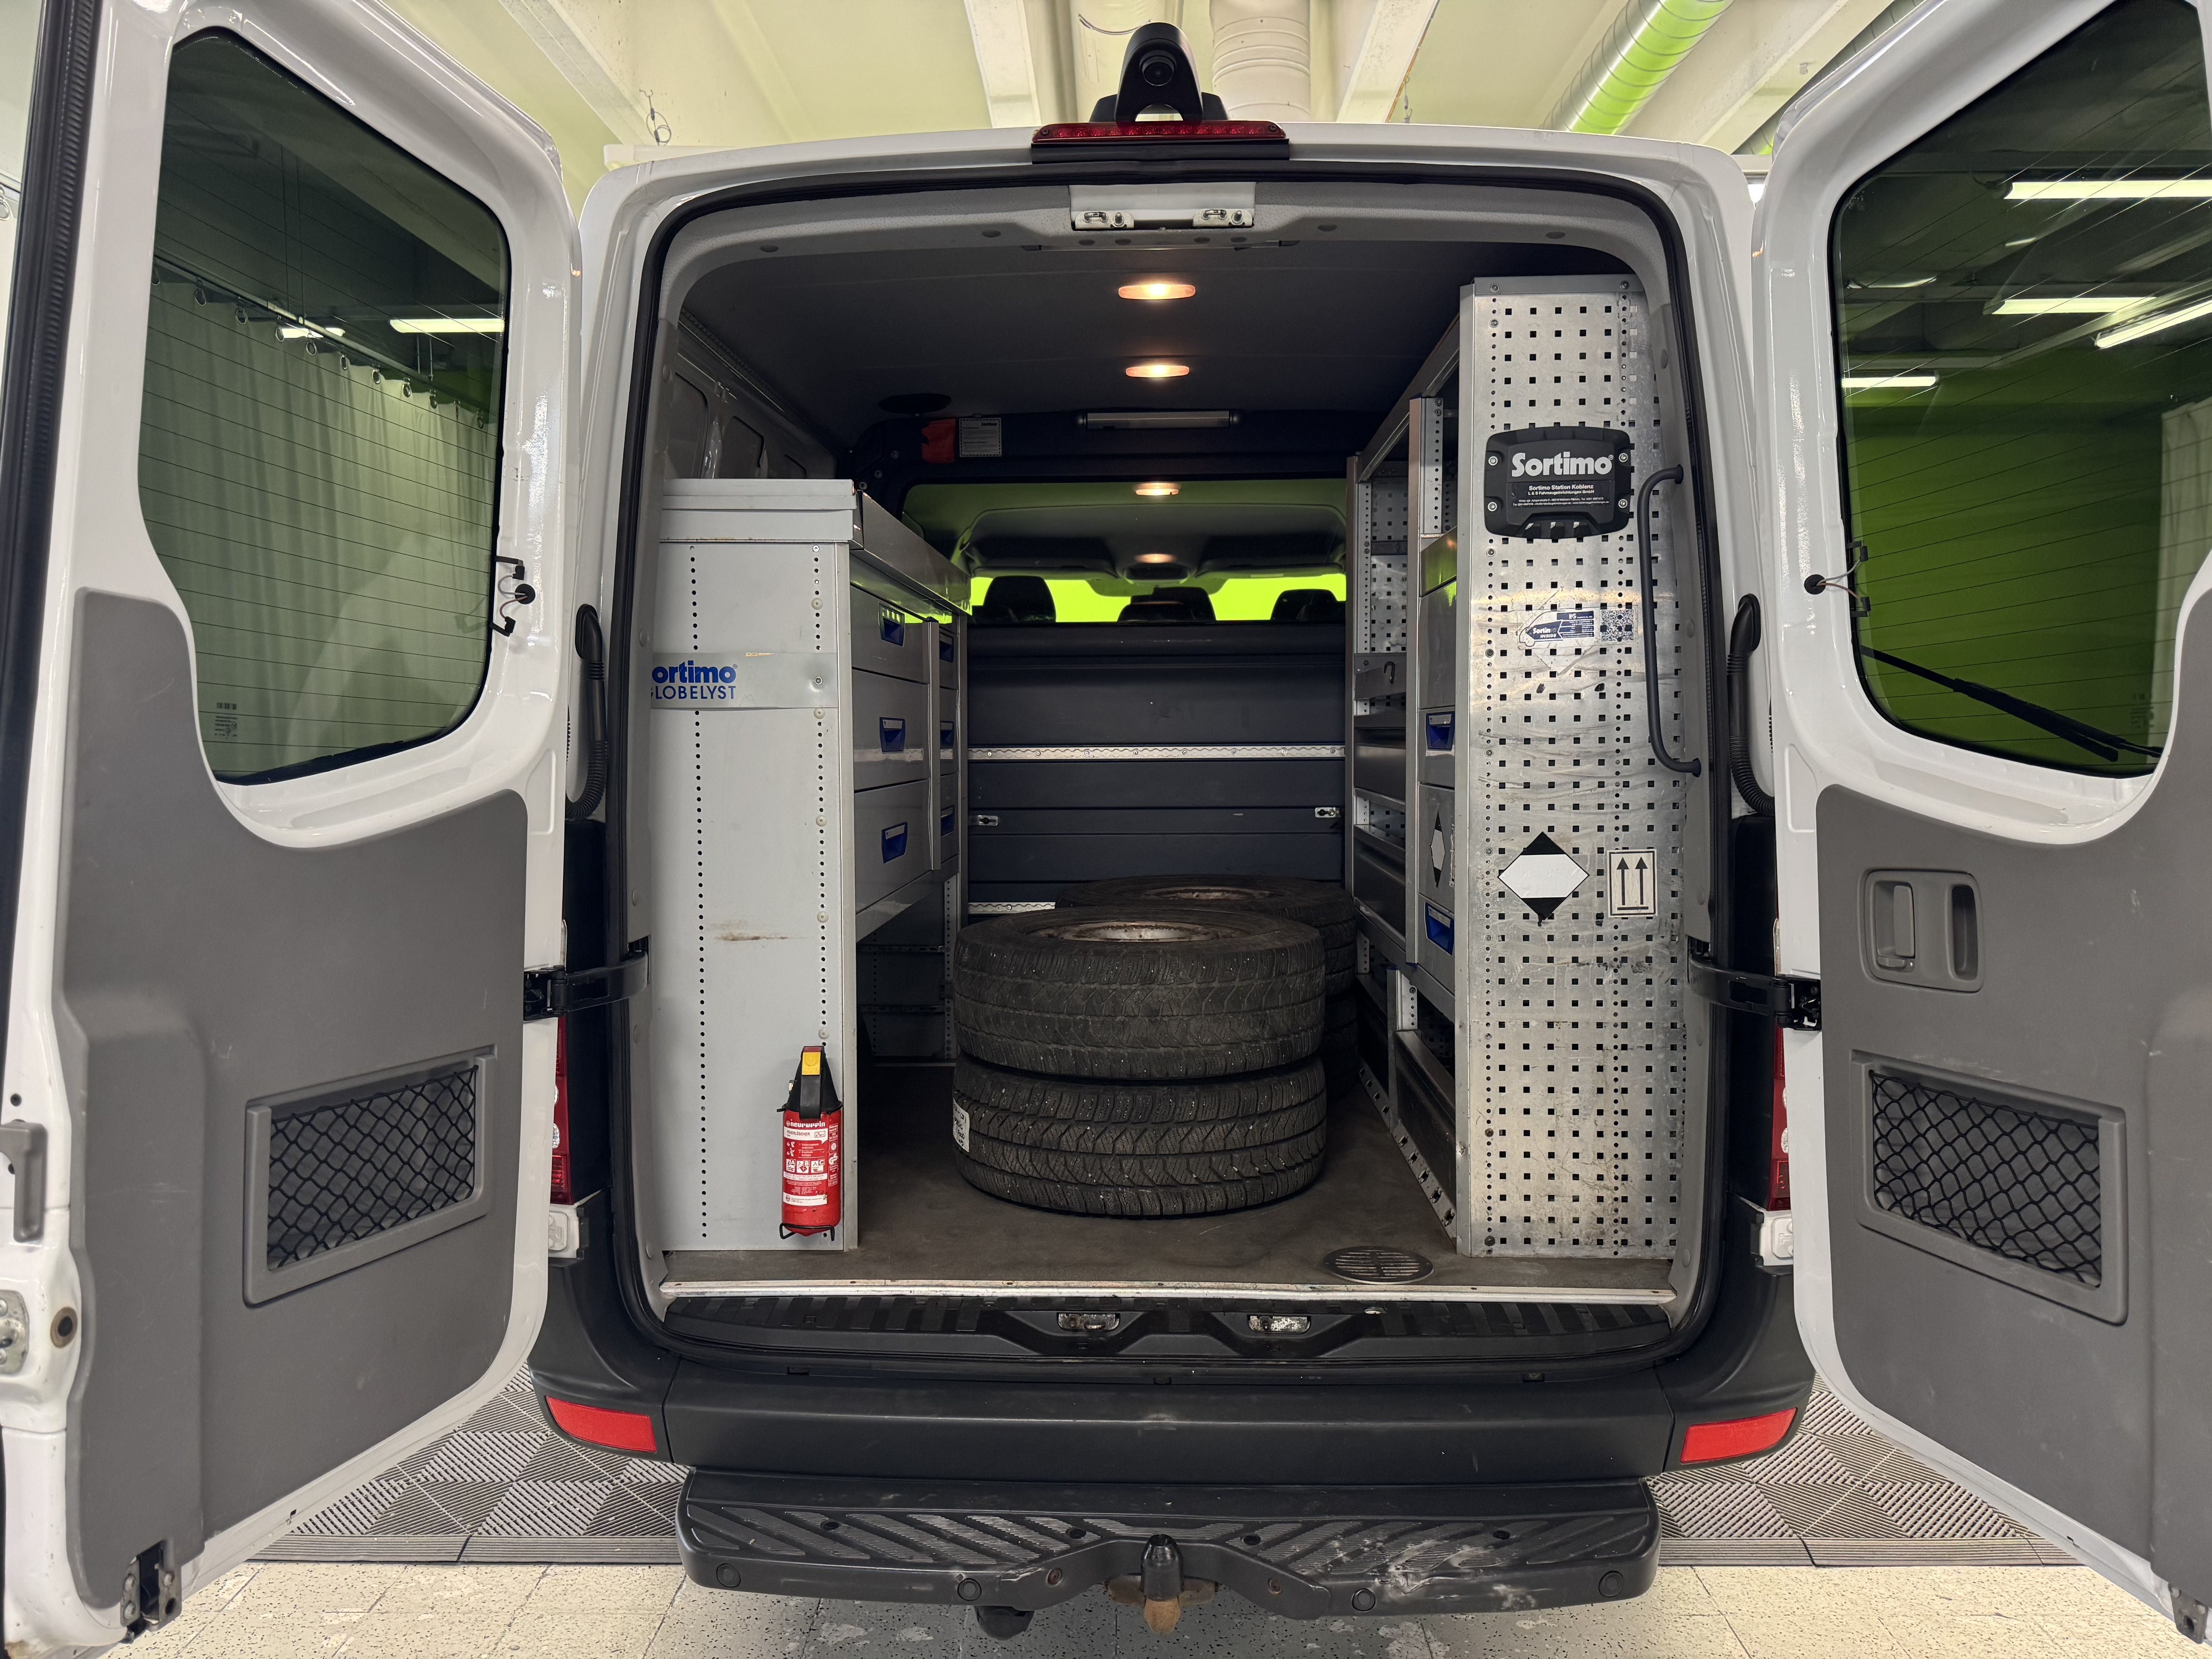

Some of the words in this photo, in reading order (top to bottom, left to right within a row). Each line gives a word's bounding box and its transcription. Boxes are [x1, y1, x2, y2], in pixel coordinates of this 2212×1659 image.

[1512, 452, 1612, 477] Sortimo
[652, 660, 736, 684] ortimo
[651, 685, 736, 699] LOBELYST
